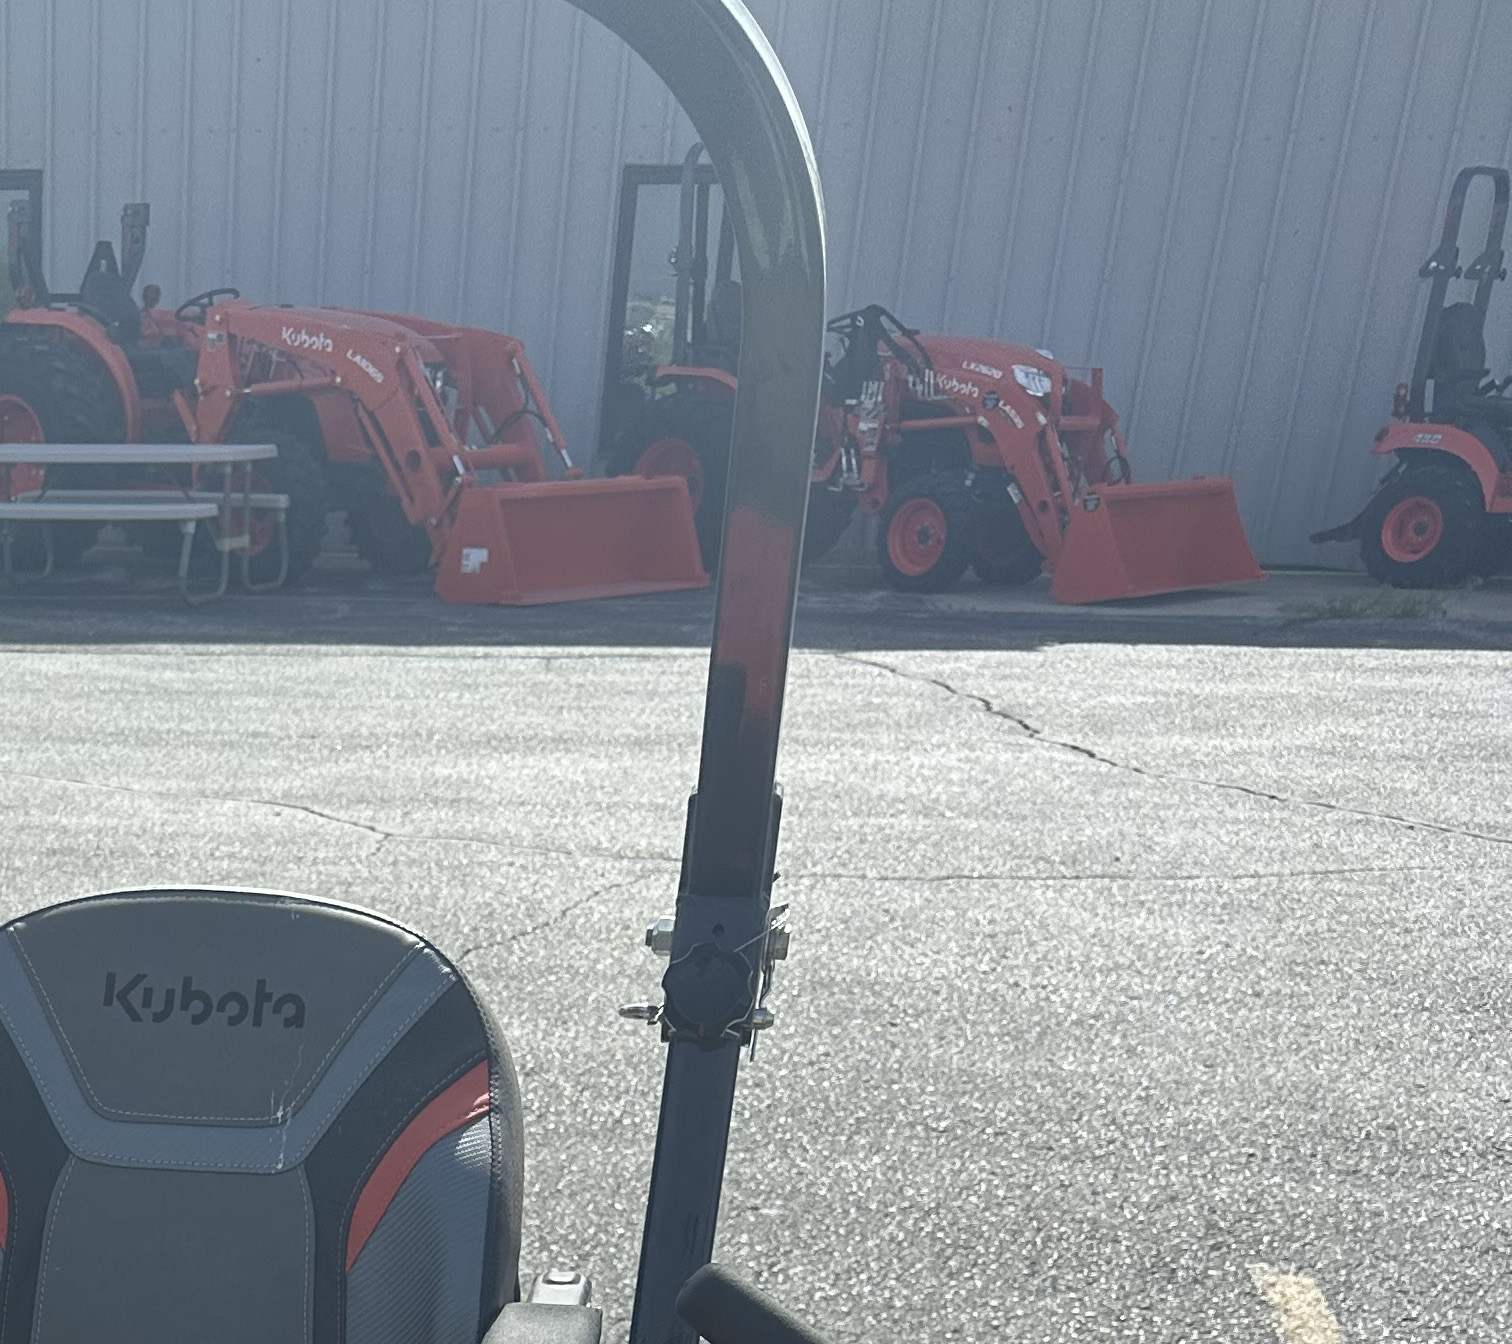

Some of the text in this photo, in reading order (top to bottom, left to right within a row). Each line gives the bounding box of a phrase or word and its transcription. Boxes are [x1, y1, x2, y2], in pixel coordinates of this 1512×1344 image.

[281, 326, 333, 352] Kubota
[937, 373, 979, 398] Kubota
[103, 971, 307, 1029] Kubota
